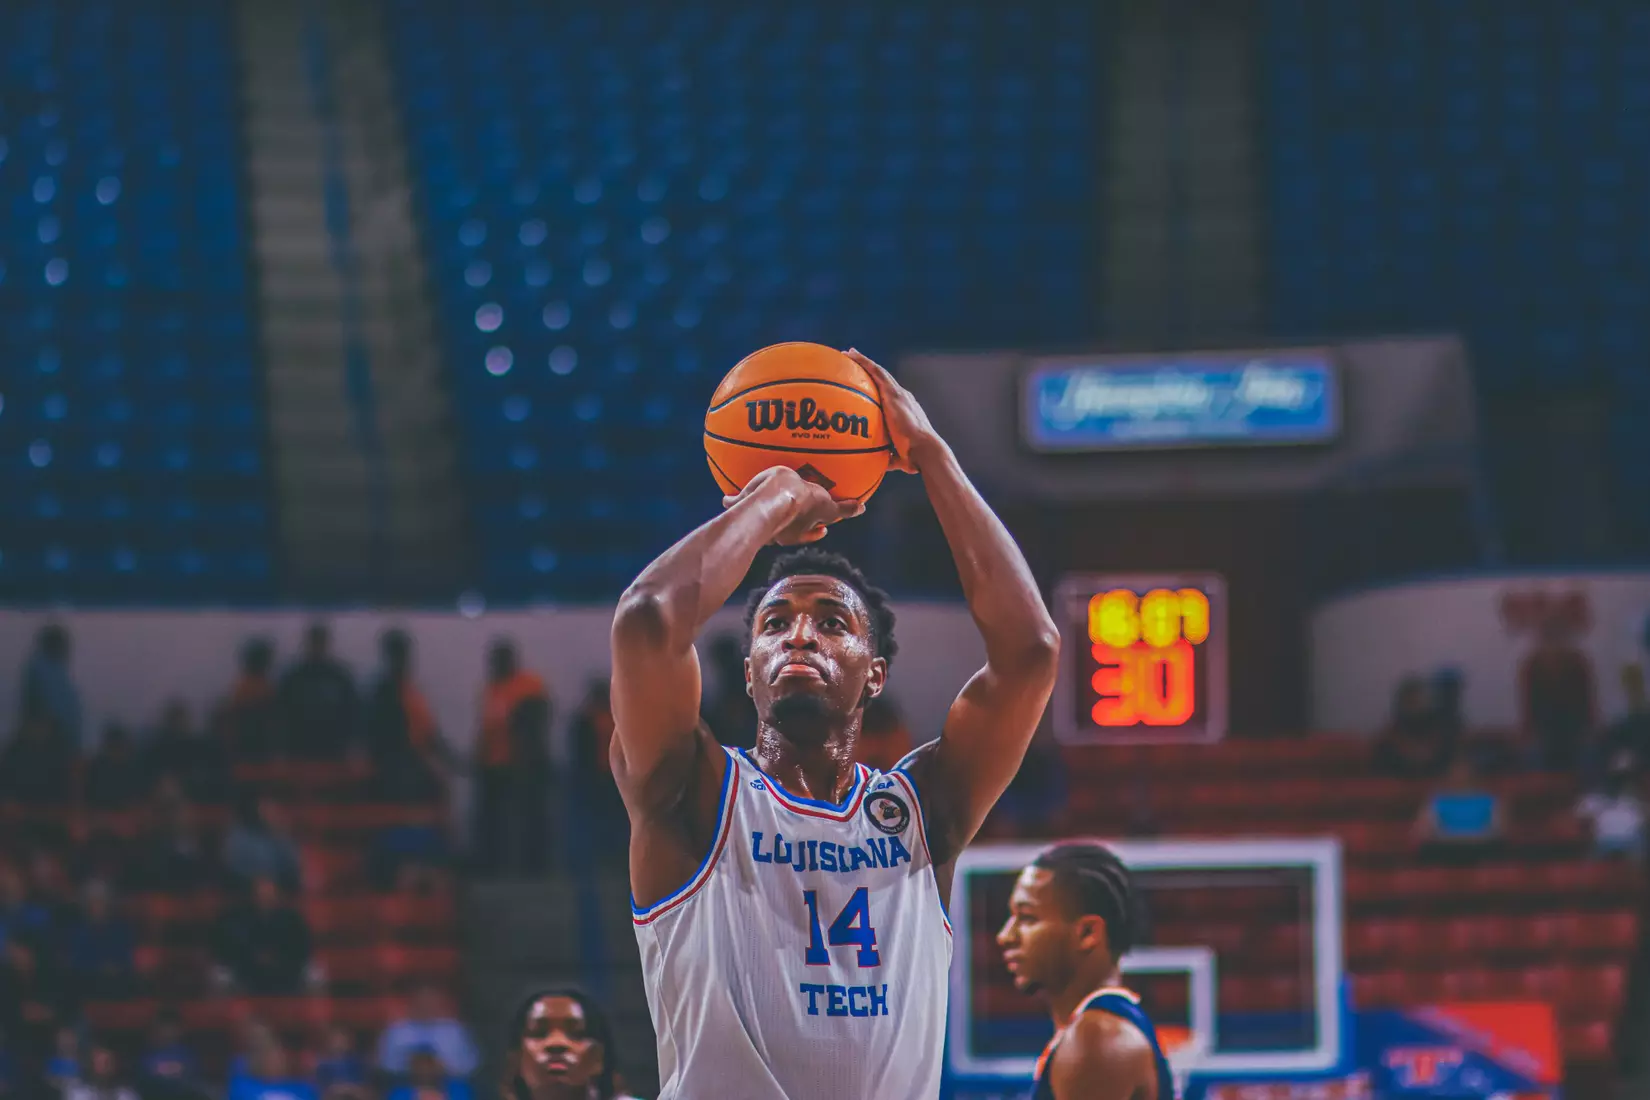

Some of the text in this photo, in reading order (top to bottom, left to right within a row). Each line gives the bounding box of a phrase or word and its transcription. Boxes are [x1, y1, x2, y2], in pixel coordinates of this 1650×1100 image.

[745, 397, 869, 438] Wilson
[1091, 640, 1195, 727] 30
[752, 831, 911, 873] LOUISIANA
[803, 887, 881, 967] 14
[800, 983, 888, 1017] TECH
